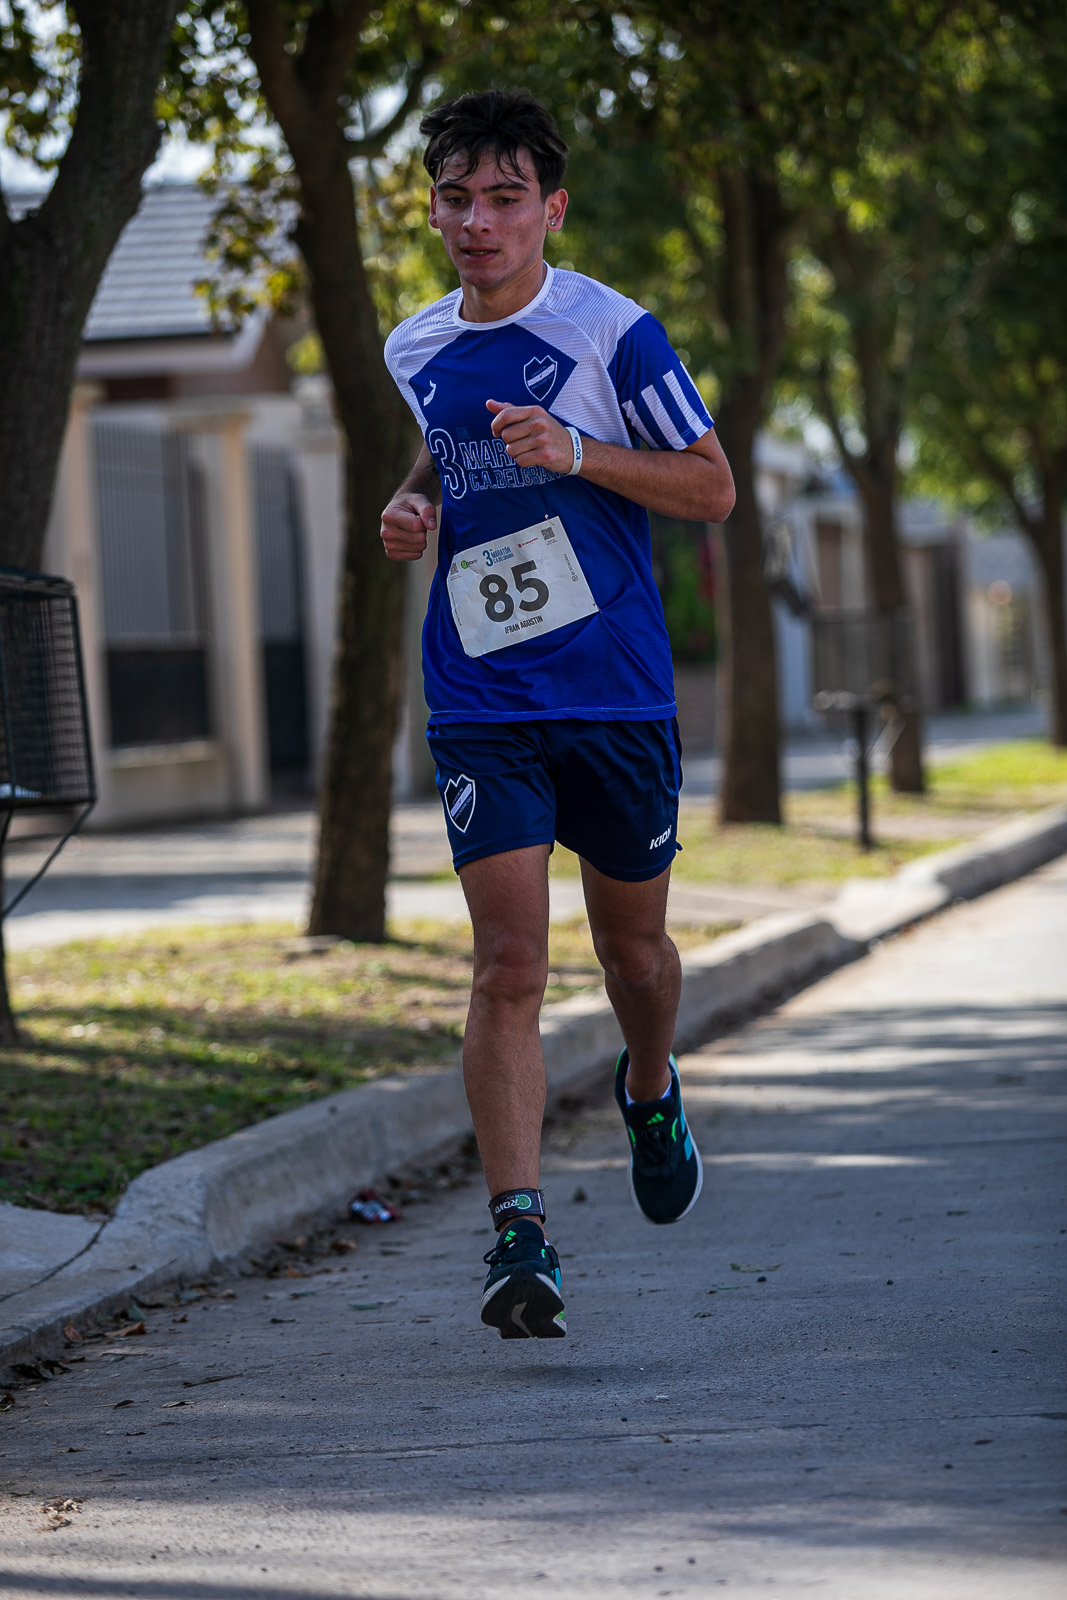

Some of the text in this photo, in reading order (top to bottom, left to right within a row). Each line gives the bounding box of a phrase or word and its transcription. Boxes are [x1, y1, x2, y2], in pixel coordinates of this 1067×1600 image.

[428, 428, 467, 499] 3
[482, 550, 494, 567] 3
[479, 560, 549, 622] 85
[504, 615, 544, 635] IFRAN AGUSTIN
